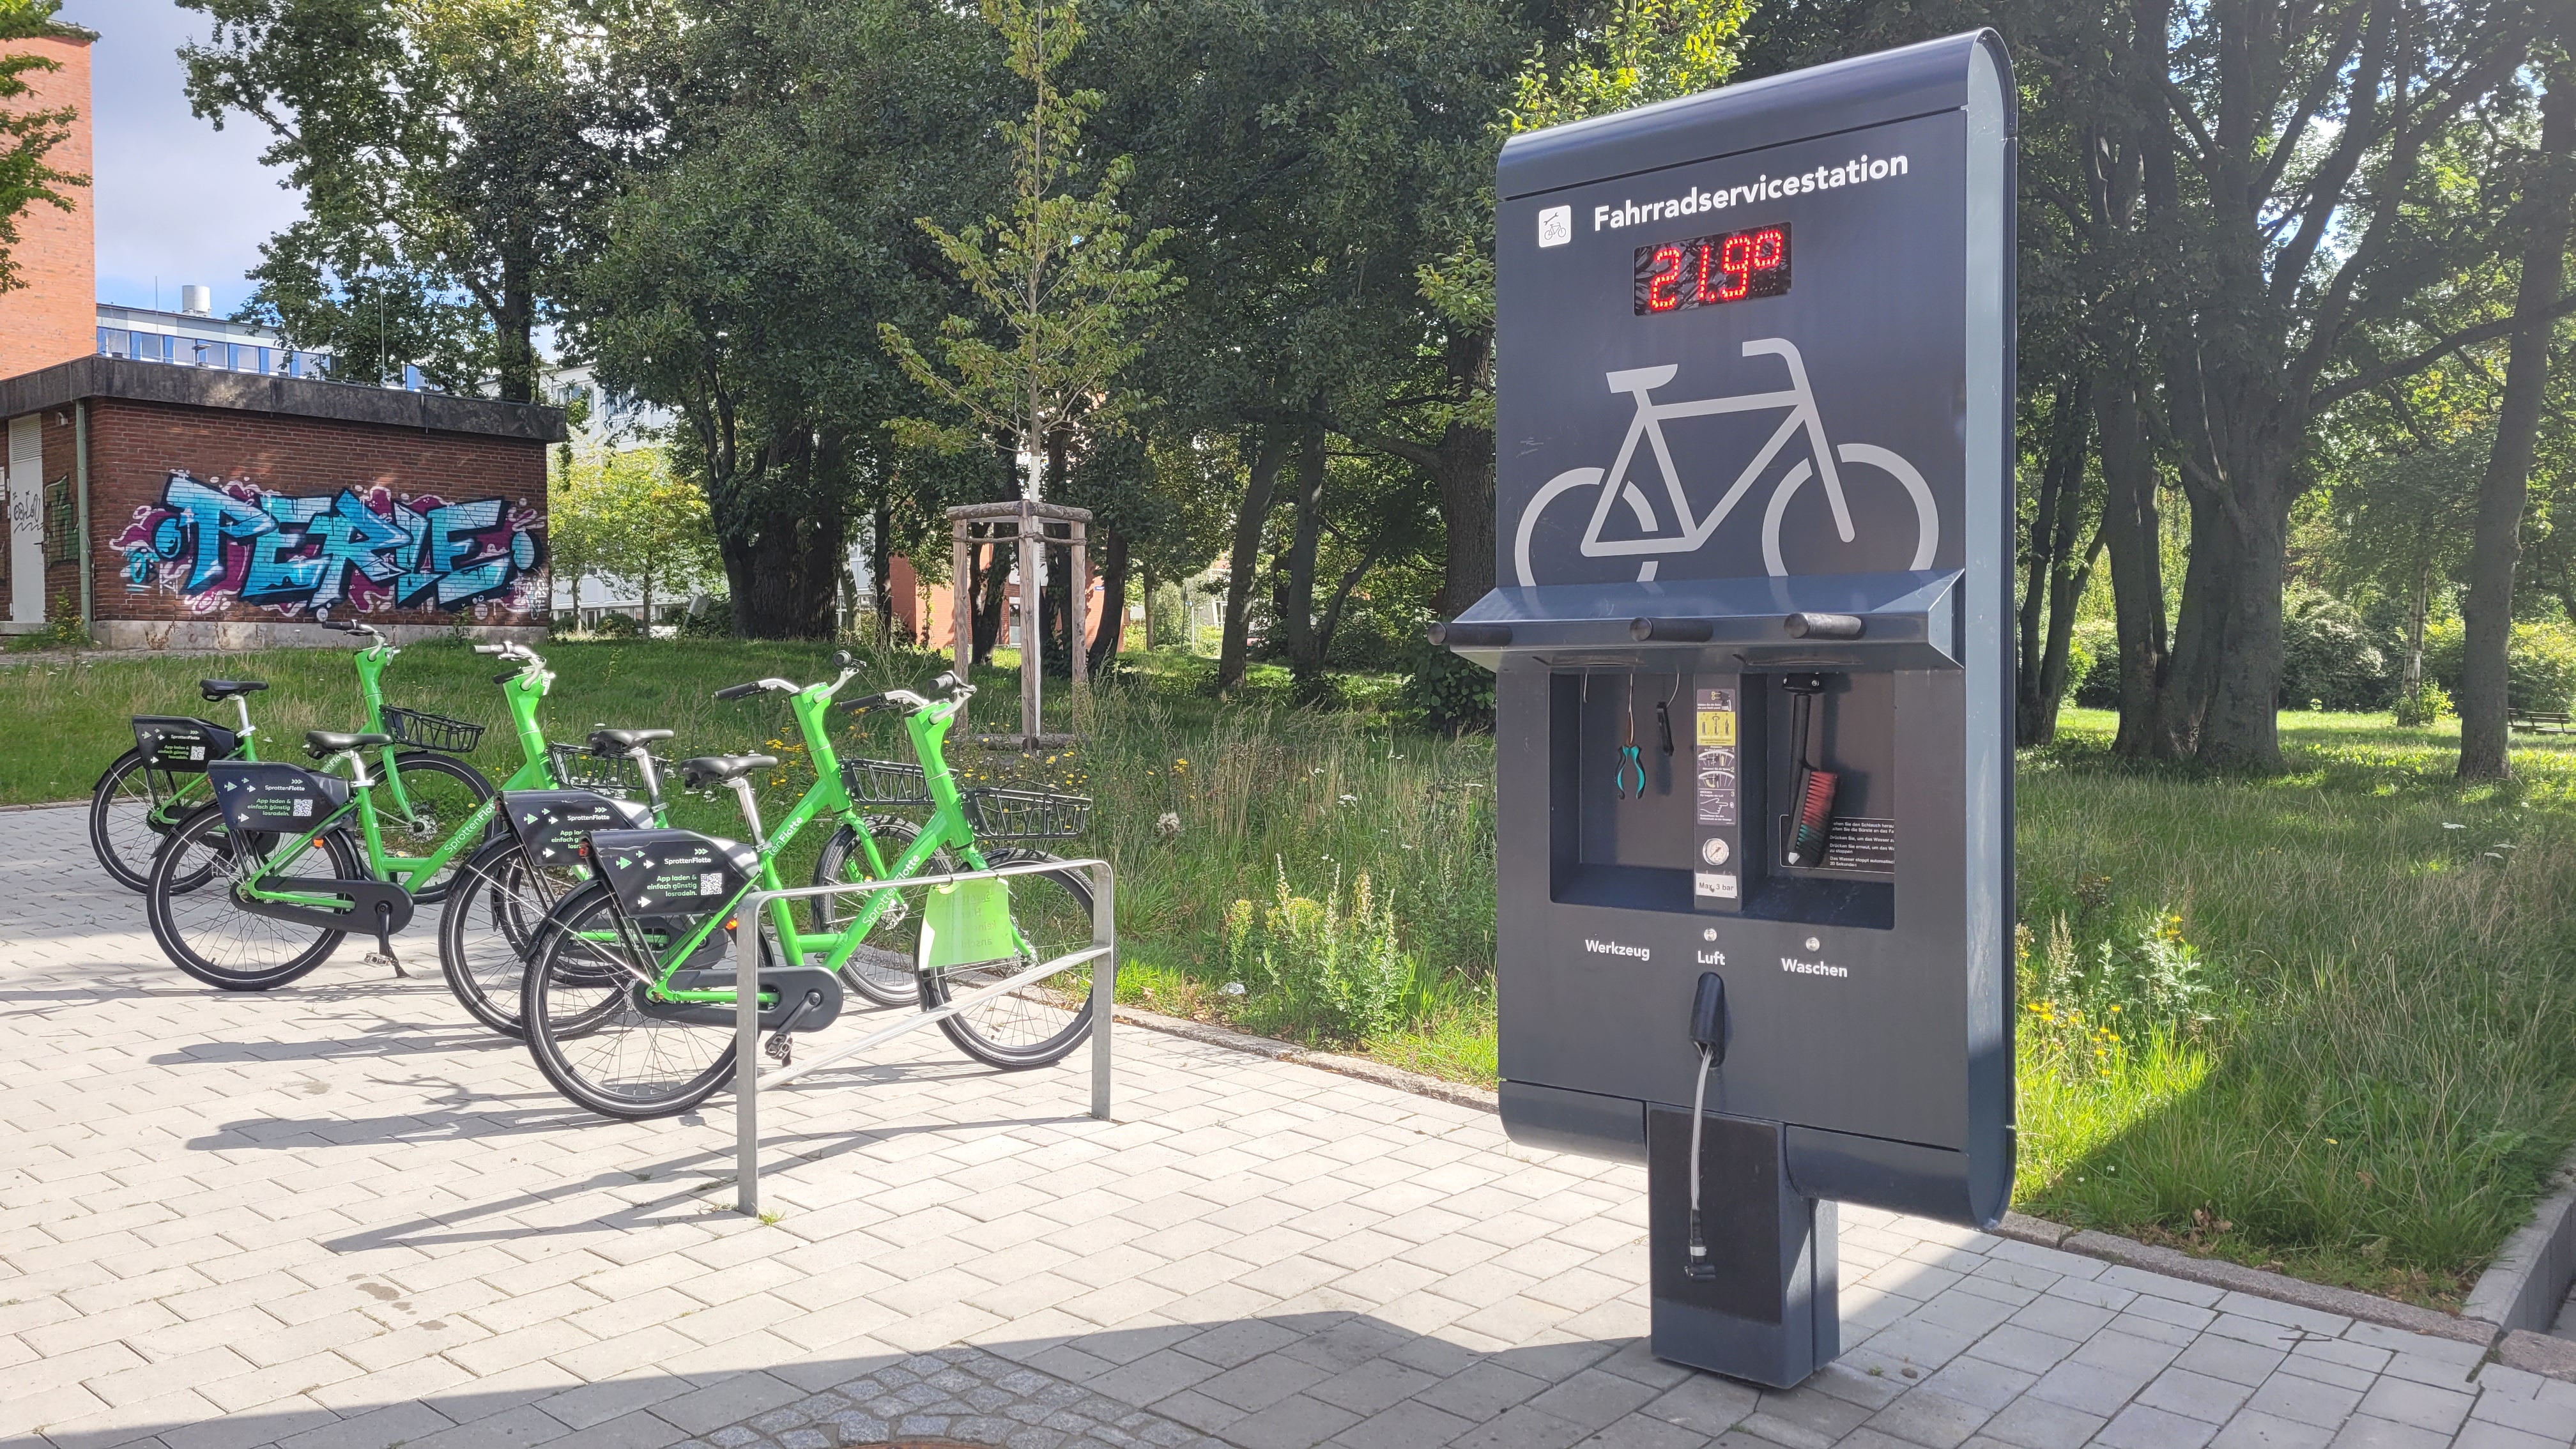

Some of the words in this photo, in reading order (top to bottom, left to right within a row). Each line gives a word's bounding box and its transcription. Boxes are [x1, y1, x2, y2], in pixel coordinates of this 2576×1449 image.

[1594, 155, 1908, 231] Fahrradservicestation
[444, 800, 495, 854] SprottenFlot
[769, 816, 802, 856] tenFlotte
[1585, 939, 1650, 962] Werkzeug
[1698, 950, 1725, 965] Luft
[1781, 958, 1848, 978] Waschen
